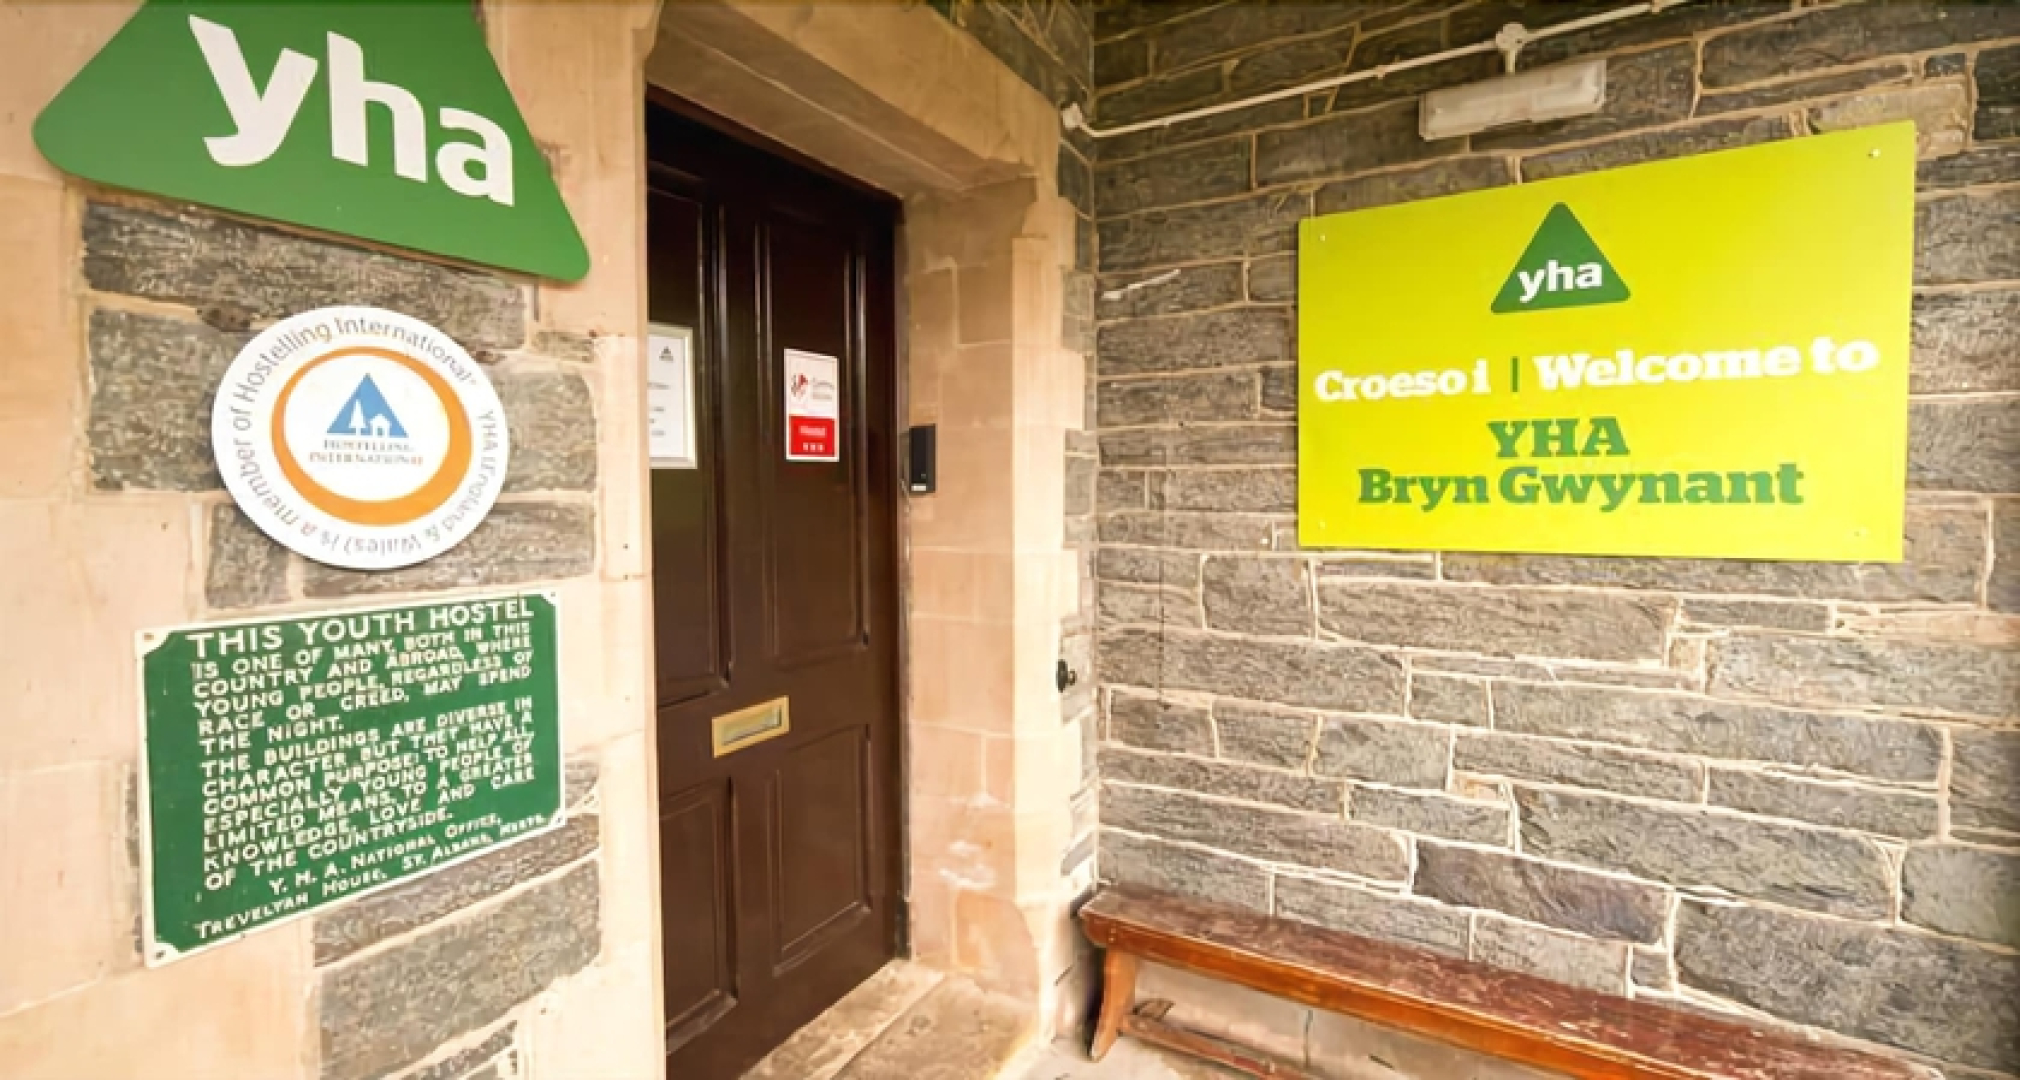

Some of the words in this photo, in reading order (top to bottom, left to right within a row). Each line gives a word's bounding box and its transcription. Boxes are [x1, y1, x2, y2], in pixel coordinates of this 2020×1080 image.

[188, 14, 514, 207] yha
[1518, 260, 1603, 302] yha
[232, 324, 332, 402] Hostelling
[1314, 368, 1467, 403] Croeso
[1473, 360, 1491, 393] i
[1531, 345, 1802, 391] Welcome
[1810, 335, 1880, 375] to
[229, 404, 254, 431] of
[478, 410, 498, 451] YHA
[1486, 416, 1631, 459] YHA
[232, 438, 299, 525] member
[1357, 468, 1491, 513] Bryn
[1498, 462, 1804, 513] Gwynant
[300, 522, 318, 536] a
[185, 626, 284, 659] THIS
[297, 611, 415, 646] YOUTH
[429, 598, 534, 630] HOSTEL
[191, 661, 219, 679] IS
[232, 653, 282, 675] ONE
[295, 646, 323, 666] OF
[404, 632, 455, 651] BOTH
[464, 627, 482, 642] IN
[492, 621, 530, 638] THIS
[193, 665, 313, 699] COUNTRY
[327, 658, 371, 680] AND
[475, 636, 531, 653] WHERE
[193, 690, 283, 718] YOUNG
[391, 655, 502, 686] REGARDLESS
[512, 651, 533, 665] OF
[198, 710, 264, 737] RACE
[286, 701, 315, 721] OR
[424, 676, 462, 695] MAY
[478, 666, 532, 686] SPEND
[200, 731, 252, 756] THE
[267, 715, 344, 743] NIGHT.
[200, 753, 252, 778] THE
[264, 729, 381, 766] BUILDINGS
[391, 717, 426, 738] ARE
[437, 702, 506, 727] DIVERSE
[514, 695, 532, 712] IN
[202, 753, 347, 797] CHARACTER
[360, 740, 401, 764] BUT
[409, 728, 459, 749] THEY
[469, 713, 513, 735] HAVE
[521, 711, 533, 723] A
[203, 776, 311, 815] COMMON
[421, 745, 448, 763] TO
[457, 732, 497, 754] HELP
[203, 788, 343, 835] ESPECIALLY
[357, 764, 427, 793] YOUNG
[439, 746, 501, 773] PEOPLE
[511, 738, 532, 754] OF
[203, 813, 305, 853] LIMITED
[399, 781, 427, 799] TO
[437, 775, 450, 791] A
[458, 753, 533, 782] GREATER
[368, 796, 420, 824] LOVE
[438, 782, 475, 805] AND
[491, 767, 534, 789] CARE
[206, 868, 236, 891] OF
[248, 849, 297, 877] THE
[307, 807, 453, 860] COUNTRYSIDE.
[269, 878, 289, 896] Y.
[295, 870, 317, 887] H.
[324, 862, 347, 878] A.
